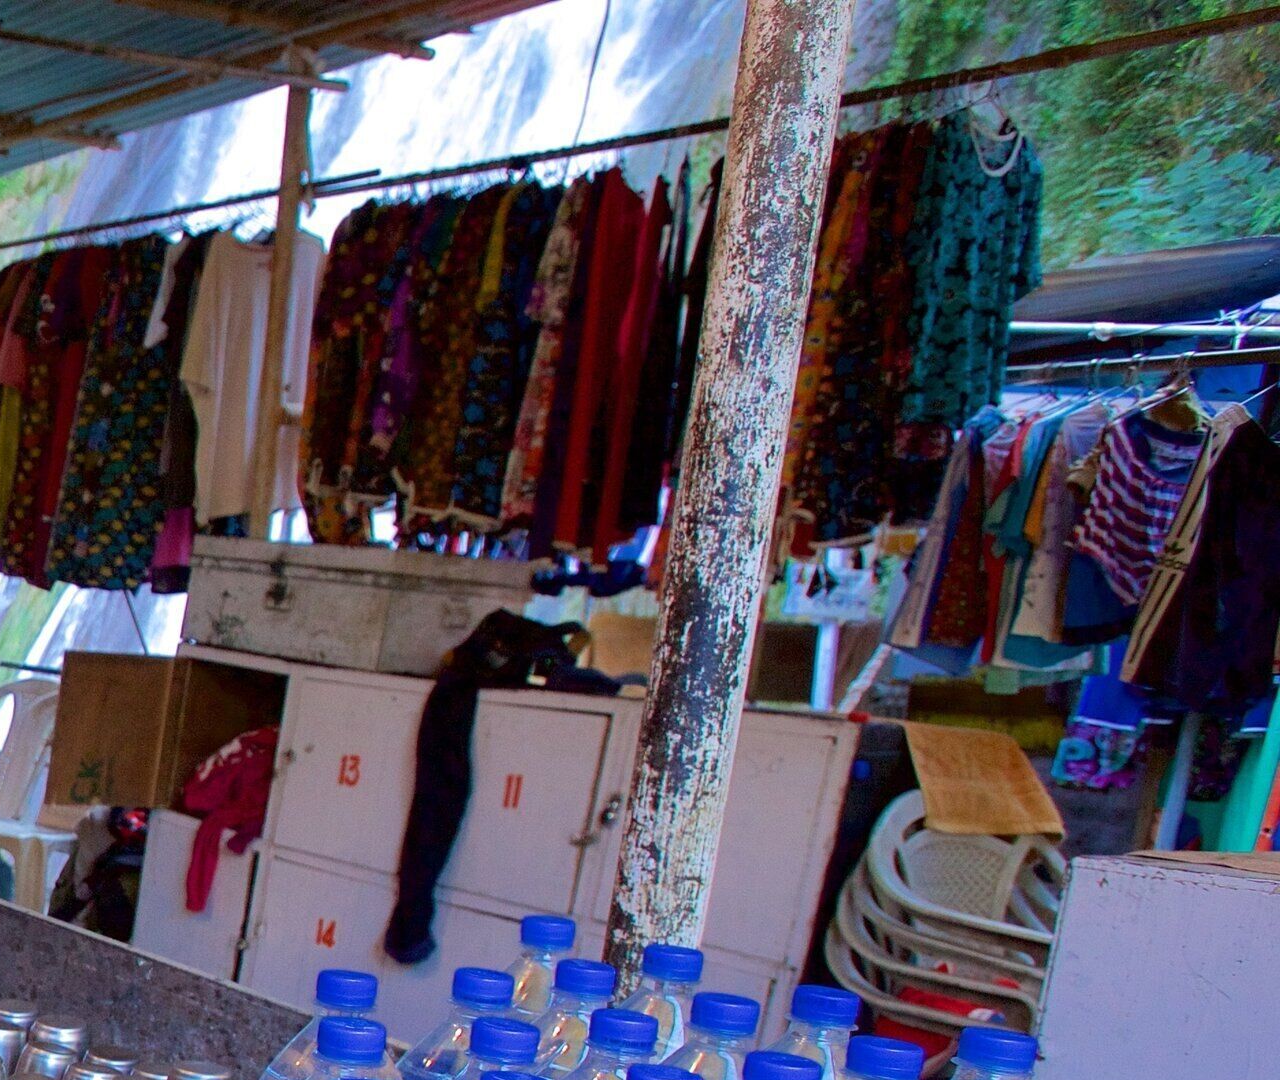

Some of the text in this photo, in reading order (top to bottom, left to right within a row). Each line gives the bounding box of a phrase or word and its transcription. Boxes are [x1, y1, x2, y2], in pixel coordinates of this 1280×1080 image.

[337, 754, 361, 787] 13
[503, 774, 524, 809] 11
[316, 918, 337, 948] 14
